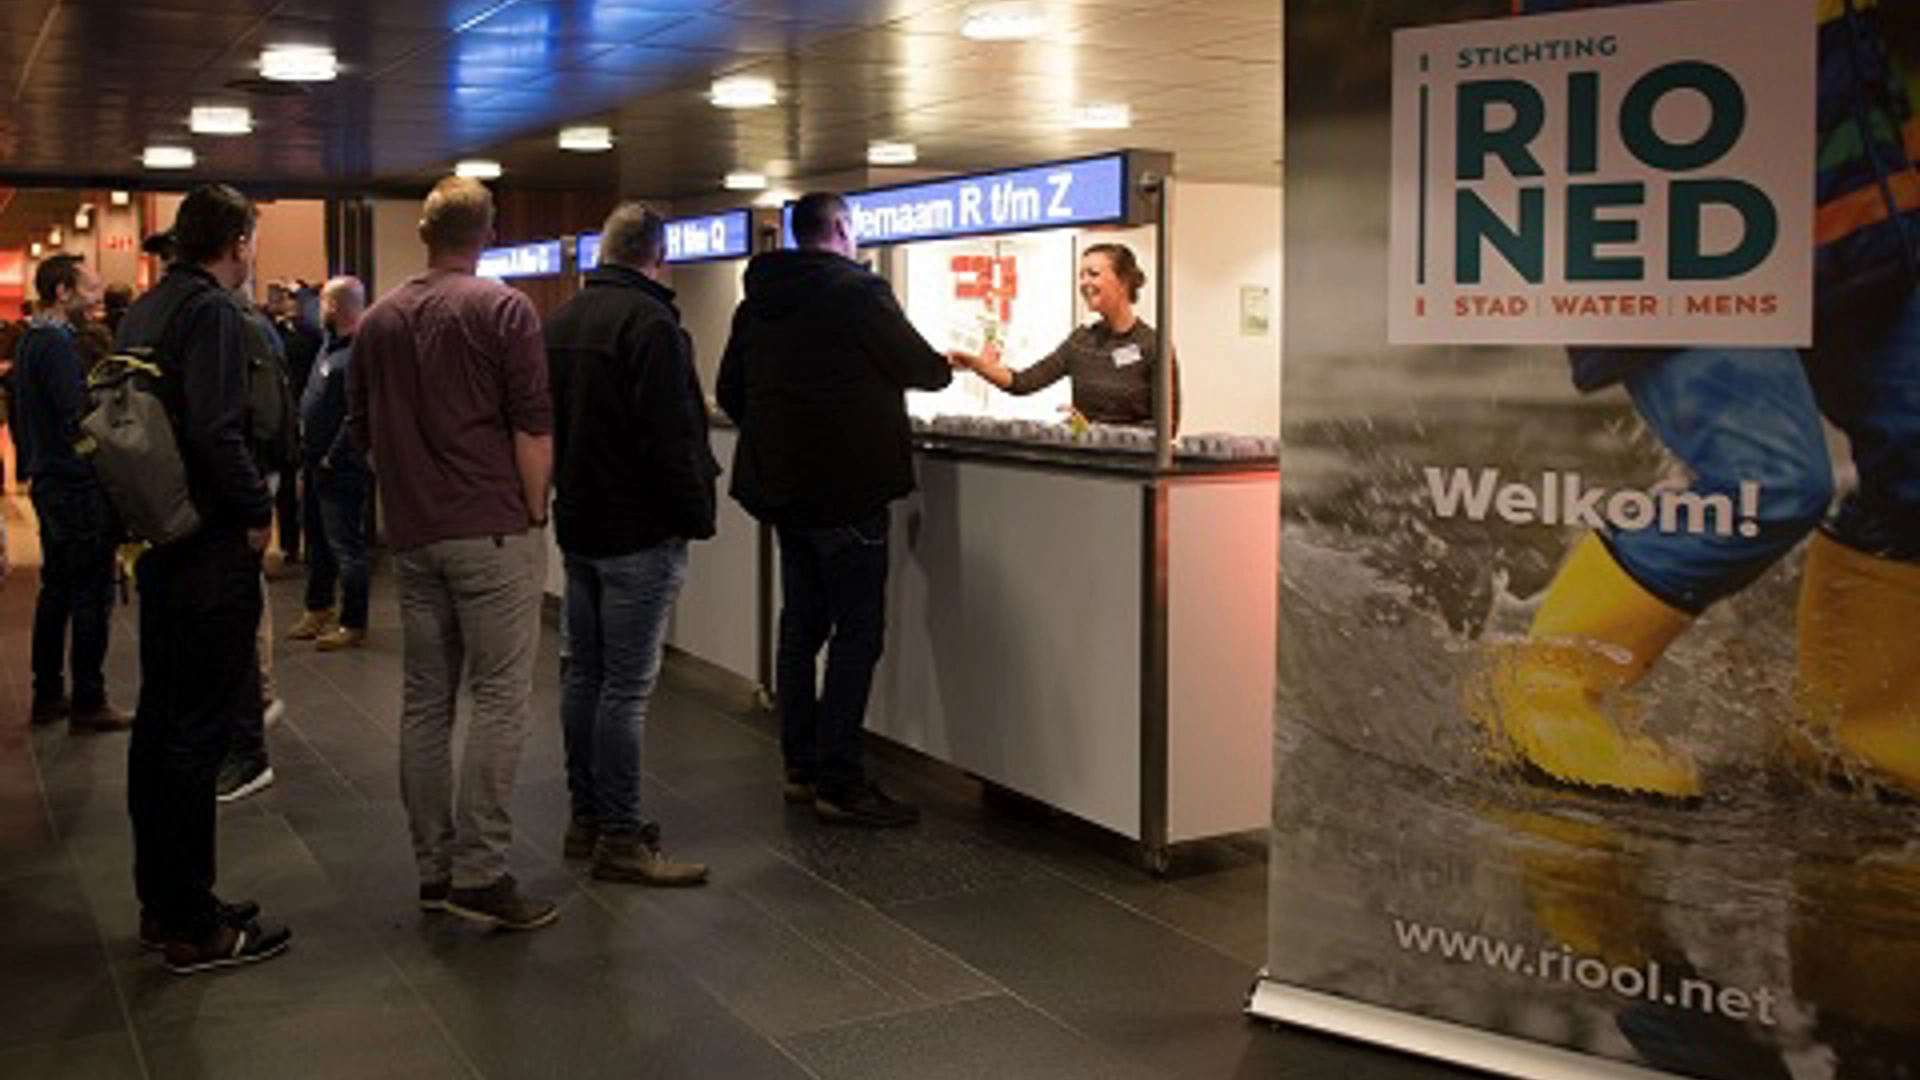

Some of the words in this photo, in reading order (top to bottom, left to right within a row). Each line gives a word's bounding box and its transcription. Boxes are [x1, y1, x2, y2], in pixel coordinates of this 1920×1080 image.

[1457, 36, 1618, 68] STICHTING
[1456, 60, 1746, 180] RIO
[960, 184, 983, 226] R
[1047, 173, 1073, 216] Z
[1455, 178, 1778, 284] NED
[1455, 296, 1528, 317] STAD
[1551, 295, 1658, 316] WATER
[1686, 295, 1778, 315] MENS
[1424, 466, 1761, 537] Welkom!
[1395, 919, 1777, 1025] www.riool.net
